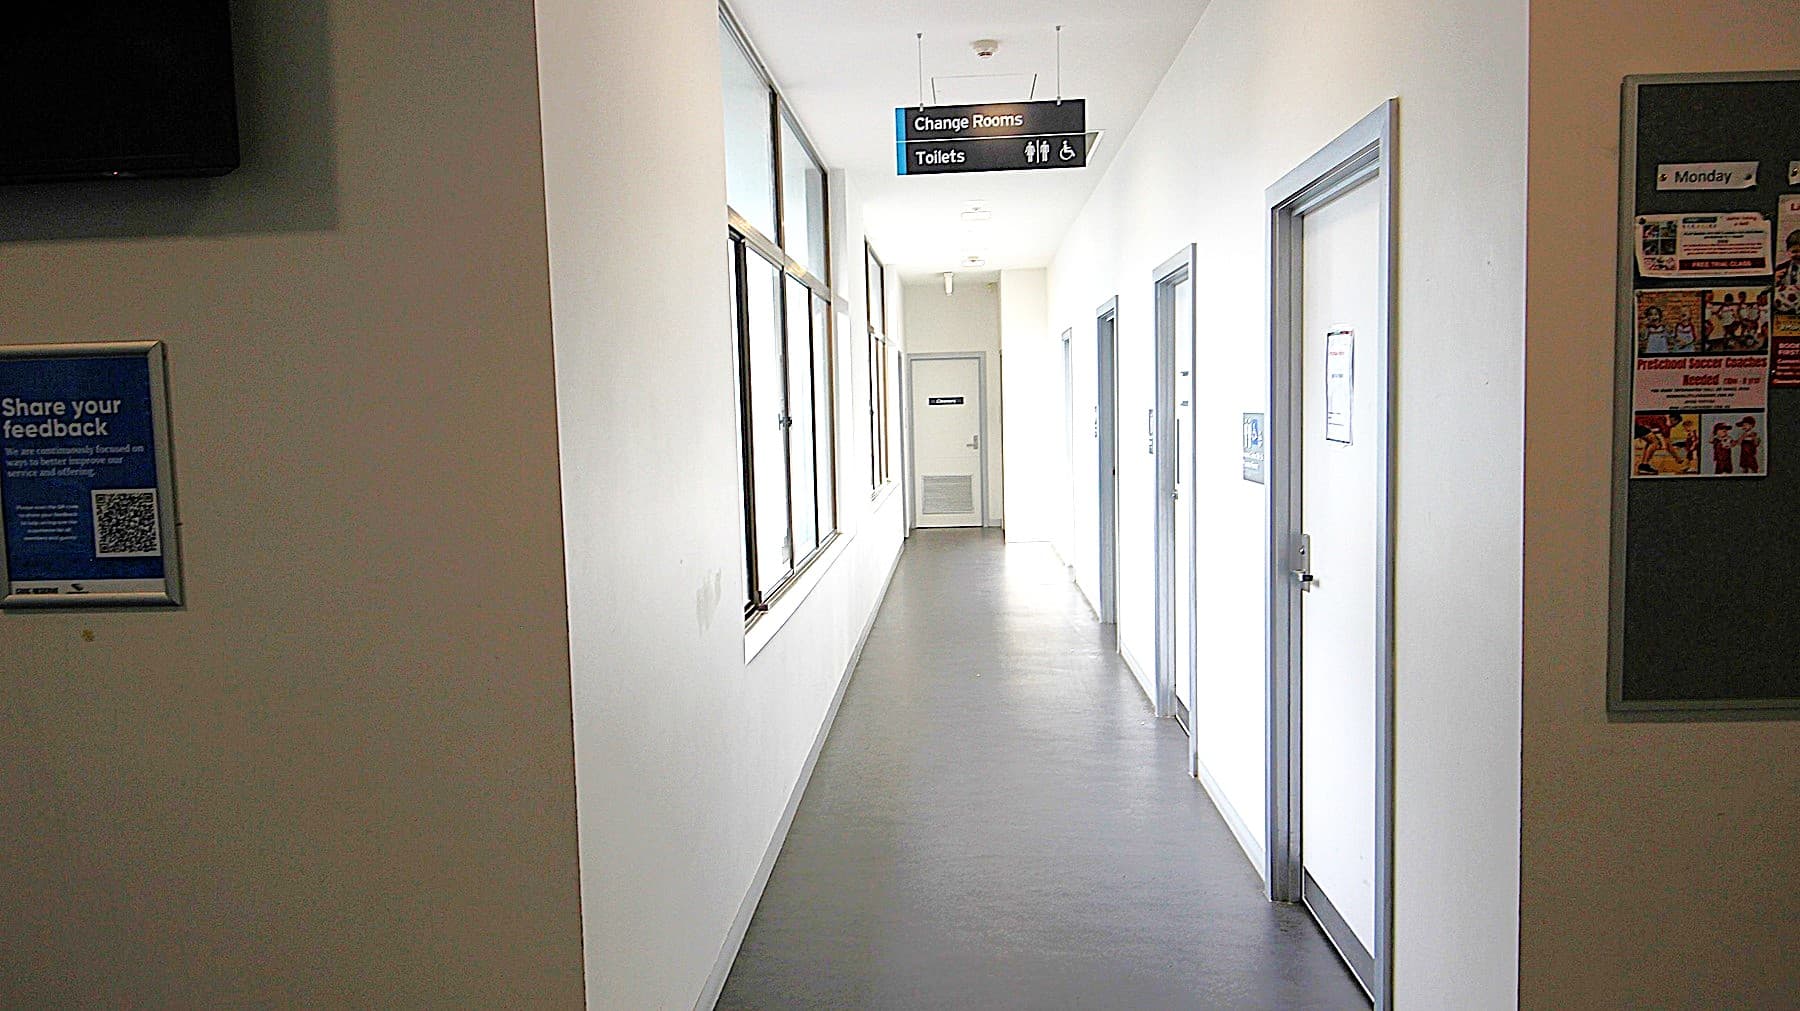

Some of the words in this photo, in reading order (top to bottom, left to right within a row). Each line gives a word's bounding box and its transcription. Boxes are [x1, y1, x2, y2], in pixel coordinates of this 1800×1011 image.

[914, 116, 969, 132] Change
[972, 114, 1024, 128] Rooms
[915, 150, 966, 165] Toilets
[1674, 169, 1733, 184] Monday
[2, 398, 66, 417] Share
[71, 399, 121, 419] your
[3, 417, 109, 439] feedback
[95, 444, 130, 454] focused
[6, 459, 27, 468] ways
[29, 458, 39, 466] to
[40, 457, 67, 466] better
[69, 456, 106, 466] improve
[107, 456, 123, 464] our
[7, 469, 37, 477] service
[39, 467, 56, 477] and
